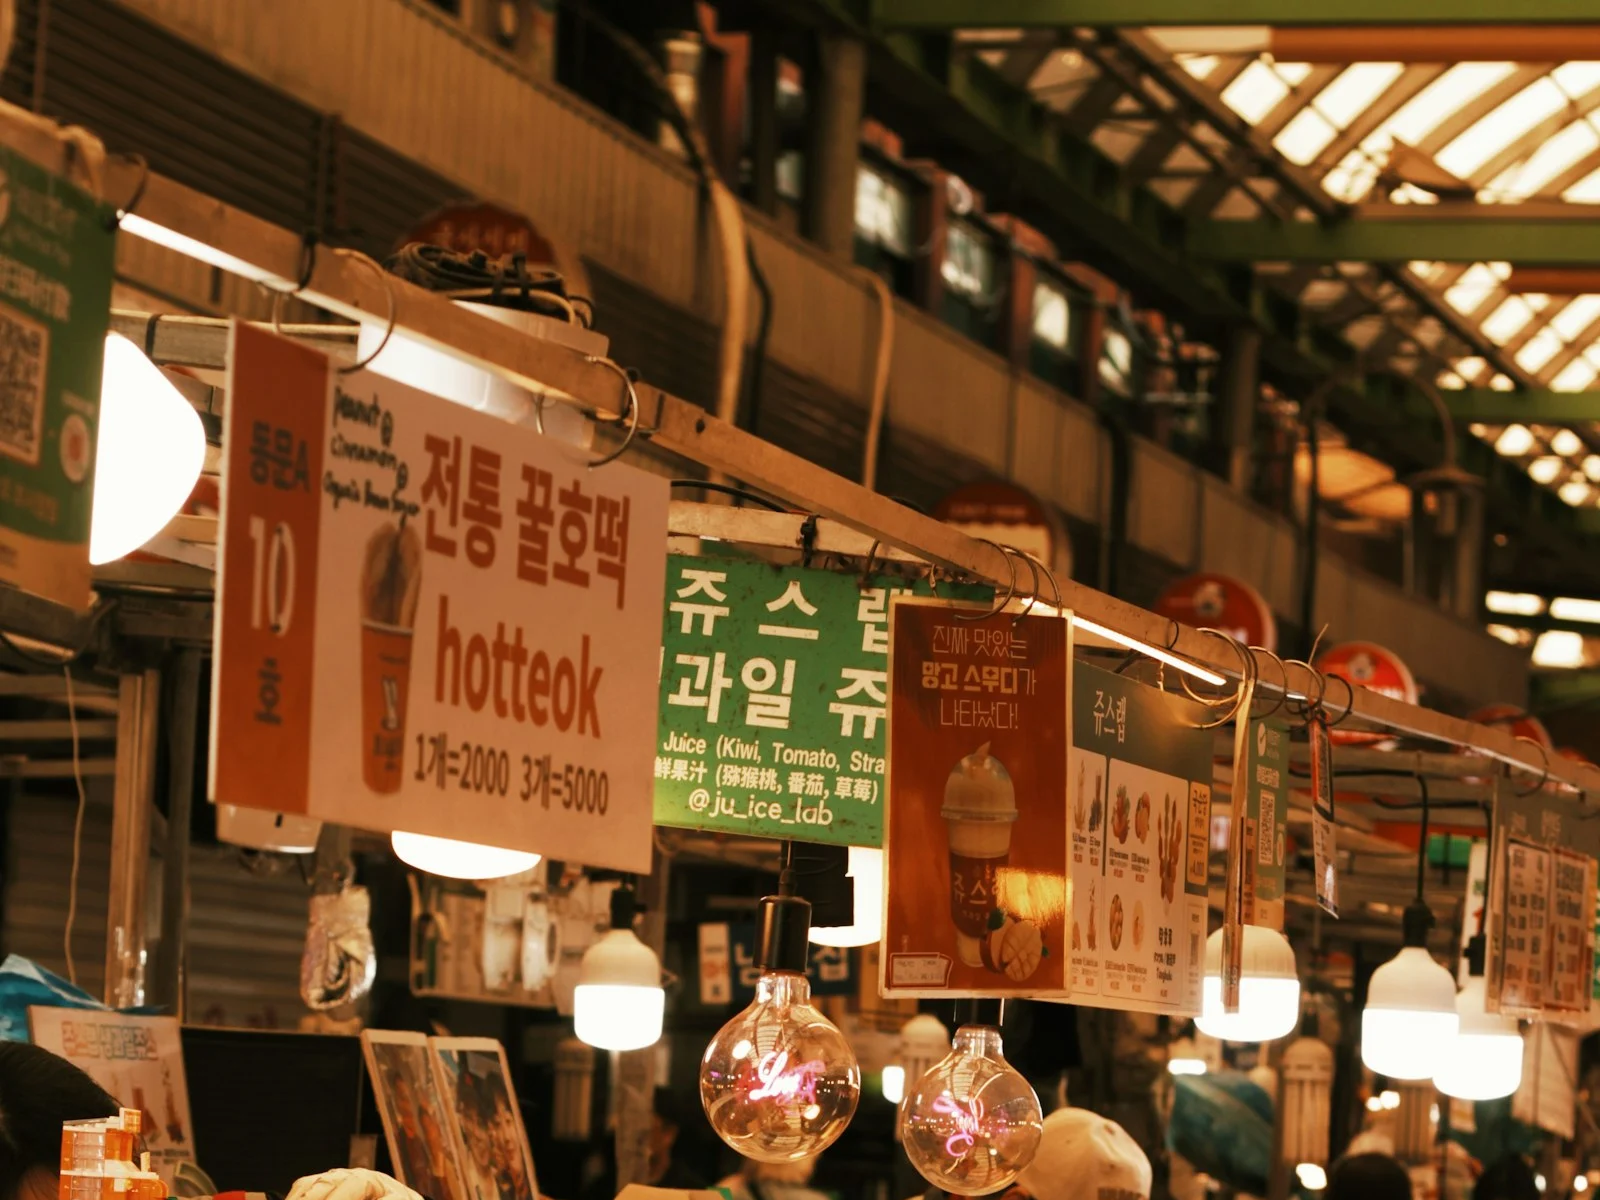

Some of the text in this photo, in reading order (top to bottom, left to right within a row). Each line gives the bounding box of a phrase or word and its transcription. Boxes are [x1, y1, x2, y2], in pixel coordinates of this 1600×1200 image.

[420, 433, 631, 611] 전통 꿀호떡
[250, 514, 297, 637] 10
[434, 595, 604, 738] hotteok
[931, 625, 1028, 660] 진짜 맛있는
[659, 647, 796, 729] 과일
[921, 660, 1037, 696] 망고 스무디가
[940, 700, 1019, 730] 나타났다!
[1092, 690, 1127, 744] 쥬스랩
[414, 733, 610, 816] 1개=2000 3개=5000
[663, 731, 885, 775] Juice (Kiwi, Tomato, Stra
[689, 788, 834, 826] @ju_ice_lab
